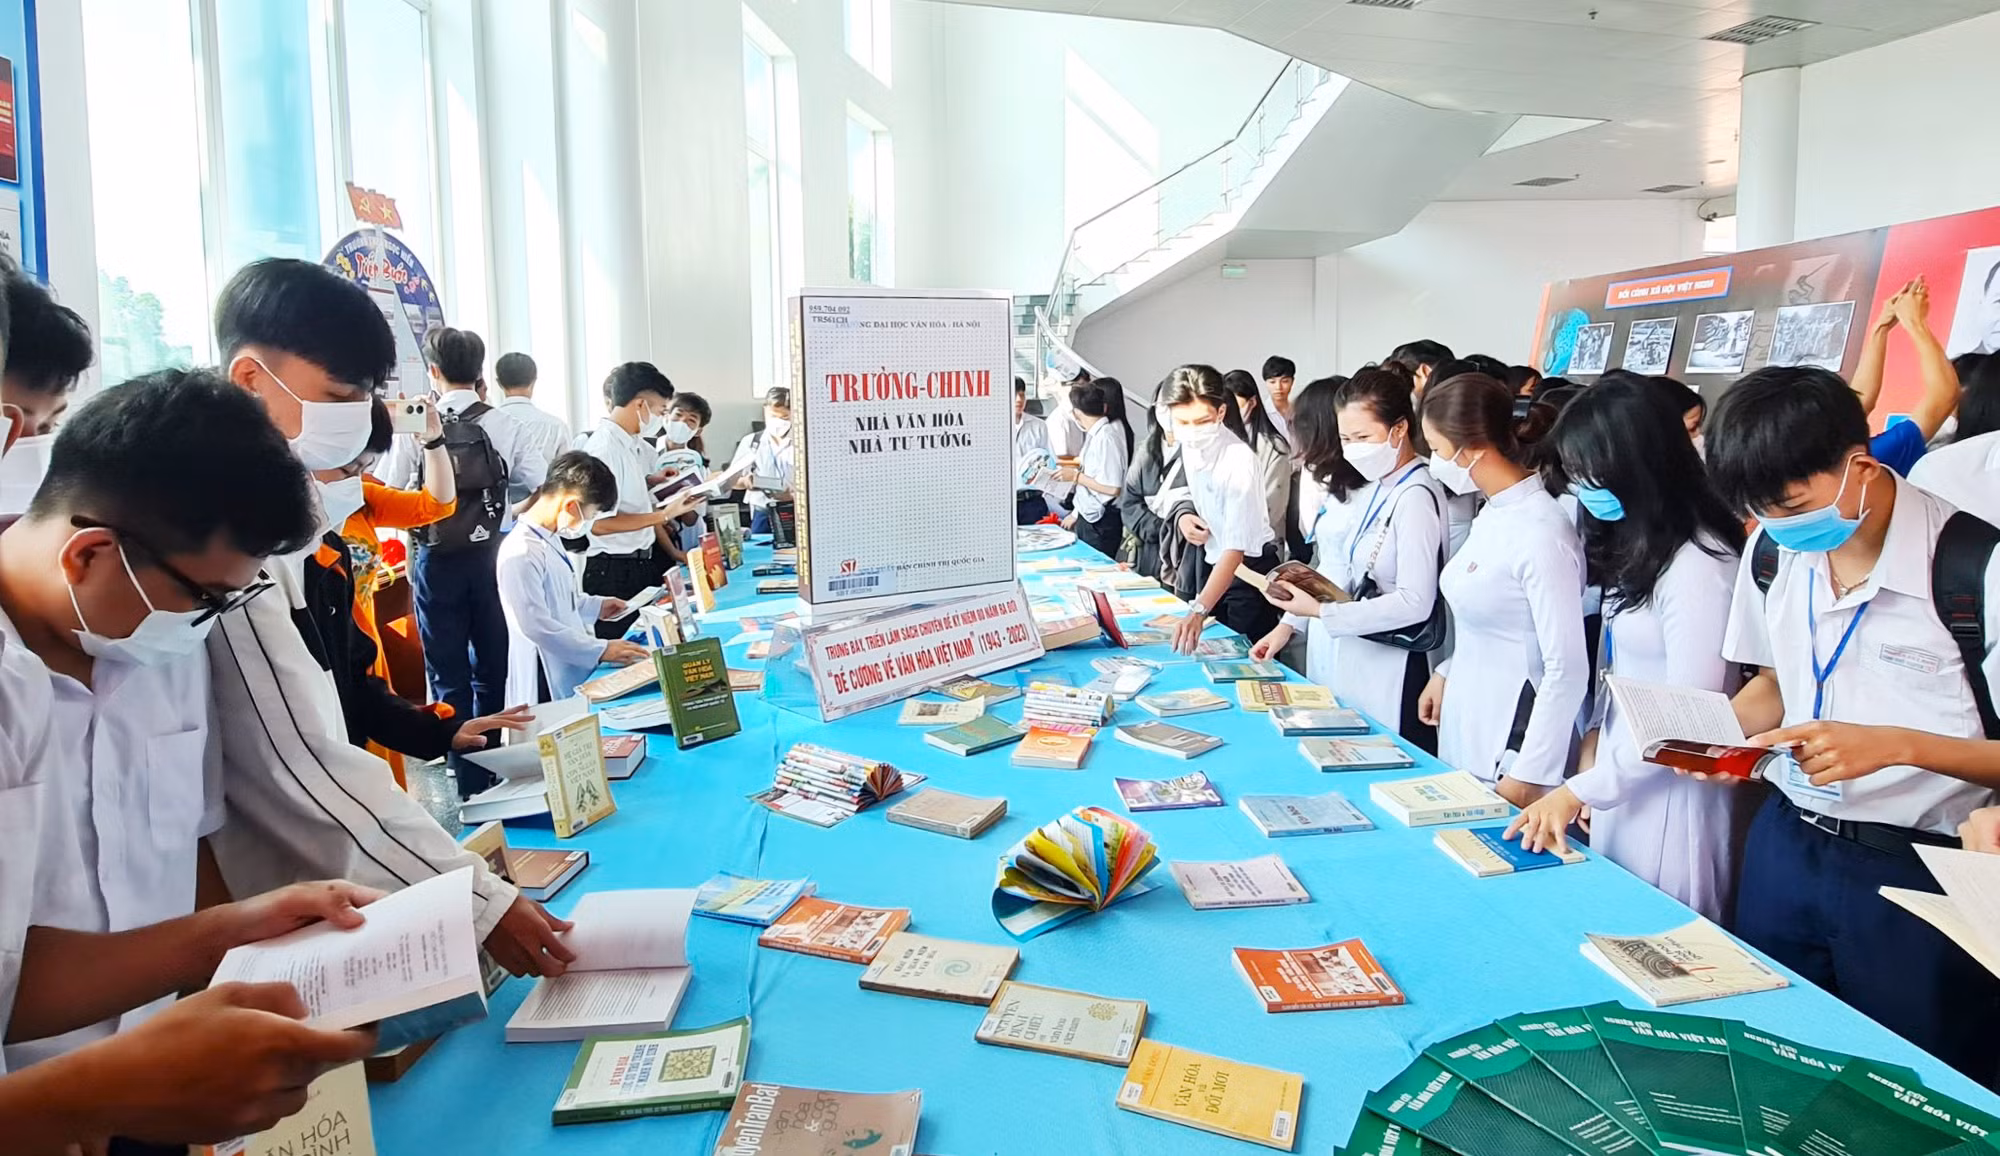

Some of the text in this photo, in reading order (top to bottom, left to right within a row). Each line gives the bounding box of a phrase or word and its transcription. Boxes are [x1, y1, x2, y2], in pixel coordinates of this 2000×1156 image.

[873, 321, 888, 330] ĐẠI
[890, 321, 908, 330] HỌC
[910, 319, 928, 328] VĂN
[825, 366, 991, 403] TRƯỜNG-CHINH
[855, 410, 964, 431] NHÀ VĂN HÓA
[849, 431, 972, 454] NHÀ TƯ TƯỞNG
[913, 560, 937, 570] CHÍNH
[951, 556, 971, 566] QUỐC
[972, 556, 986, 564] GIA
[825, 641, 850, 660] TRƯNG
[865, 628, 886, 650] TRIỂN
[901, 624, 920, 640] SÁCH
[918, 616, 944, 637] CHUYÊN
[943, 612, 953, 630] ĐỀ
[961, 609, 978, 626] NIỆM
[984, 603, 1000, 619] NĂM
[849, 663, 883, 690] CƯƠNG
[882, 652, 897, 680] VỀ
[895, 651, 917, 676] VĂN
[915, 645, 936, 671] HÓA
[933, 640, 954, 667] VIỆT
[978, 630, 1003, 654] (1943
[1006, 623, 1030, 645] 2023)
[1679, 1032, 1706, 1044] VIỆT
[1772, 1046, 1797, 1060] VĂN
[1799, 1055, 1826, 1069] HÓA
[1170, 1060, 1202, 1108] VĂN HÓA
[804, 1119, 820, 1132] &
[1894, 1090, 1989, 1138] VĂN HÓA VIỆT
[301, 1110, 347, 1150] HÓA
[303, 1128, 350, 1156] ÌNH
